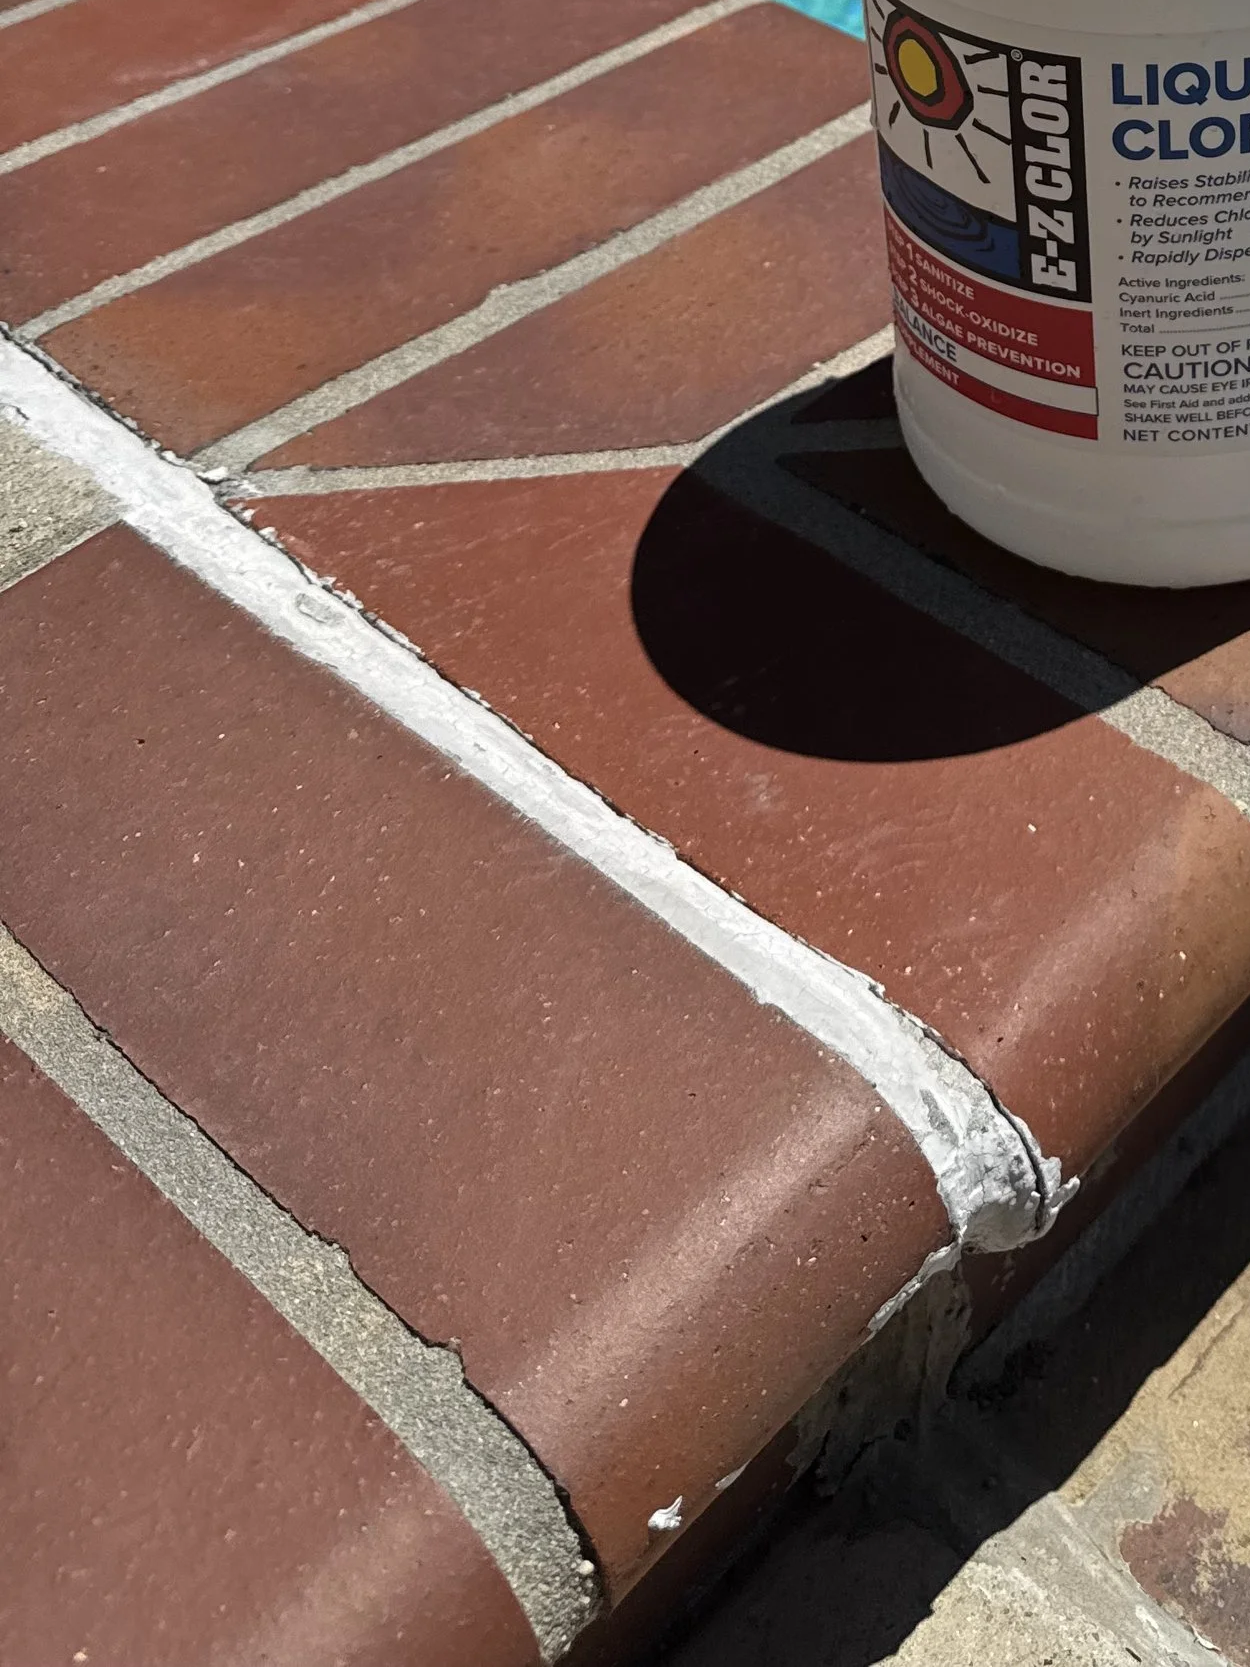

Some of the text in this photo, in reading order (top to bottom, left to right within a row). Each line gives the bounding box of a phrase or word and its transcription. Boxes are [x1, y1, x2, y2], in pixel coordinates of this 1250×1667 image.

[1128, 176, 1189, 190] Raises
[1129, 195, 1148, 207] to
[1130, 214, 1208, 227] Reduces
[1131, 228, 1233, 247] by Sunlight
[1131, 250, 1200, 266] Rapidly
[906, 242, 913, 262] 1
[916, 253, 975, 301] SANITIZE
[1119, 274, 1245, 289] Active Ingredients:
[908, 264, 918, 286] 2
[919, 278, 1039, 346] SHOCK-OXIDIZE
[1119, 292, 1180, 304] Cyanuric
[1184, 291, 1215, 302] Acid
[1119, 308, 1151, 318] Inert
[1155, 306, 1233, 321] Ingredients
[910, 287, 920, 308] 3
[922, 302, 964, 338] ALGAE
[967, 331, 1081, 379] PREVENTION
[1120, 323, 1154, 333] Total
[897, 317, 960, 387] PPLEMENT
[1121, 345, 1166, 357] KEEP
[1172, 344, 1210, 356] OUT
[1216, 340, 1240, 354] OF
[1123, 384, 1155, 394] MAY
[1159, 383, 1208, 395] CAUSE
[1212, 380, 1238, 392] EYE
[1124, 399, 1147, 409] See
[1150, 399, 1175, 409] First
[1179, 398, 1199, 408] Aid
[1203, 397, 1225, 407] and
[1125, 413, 1171, 423] SHAKE
[1176, 412, 1212, 423] WELL
[1123, 429, 1160, 441] NET
